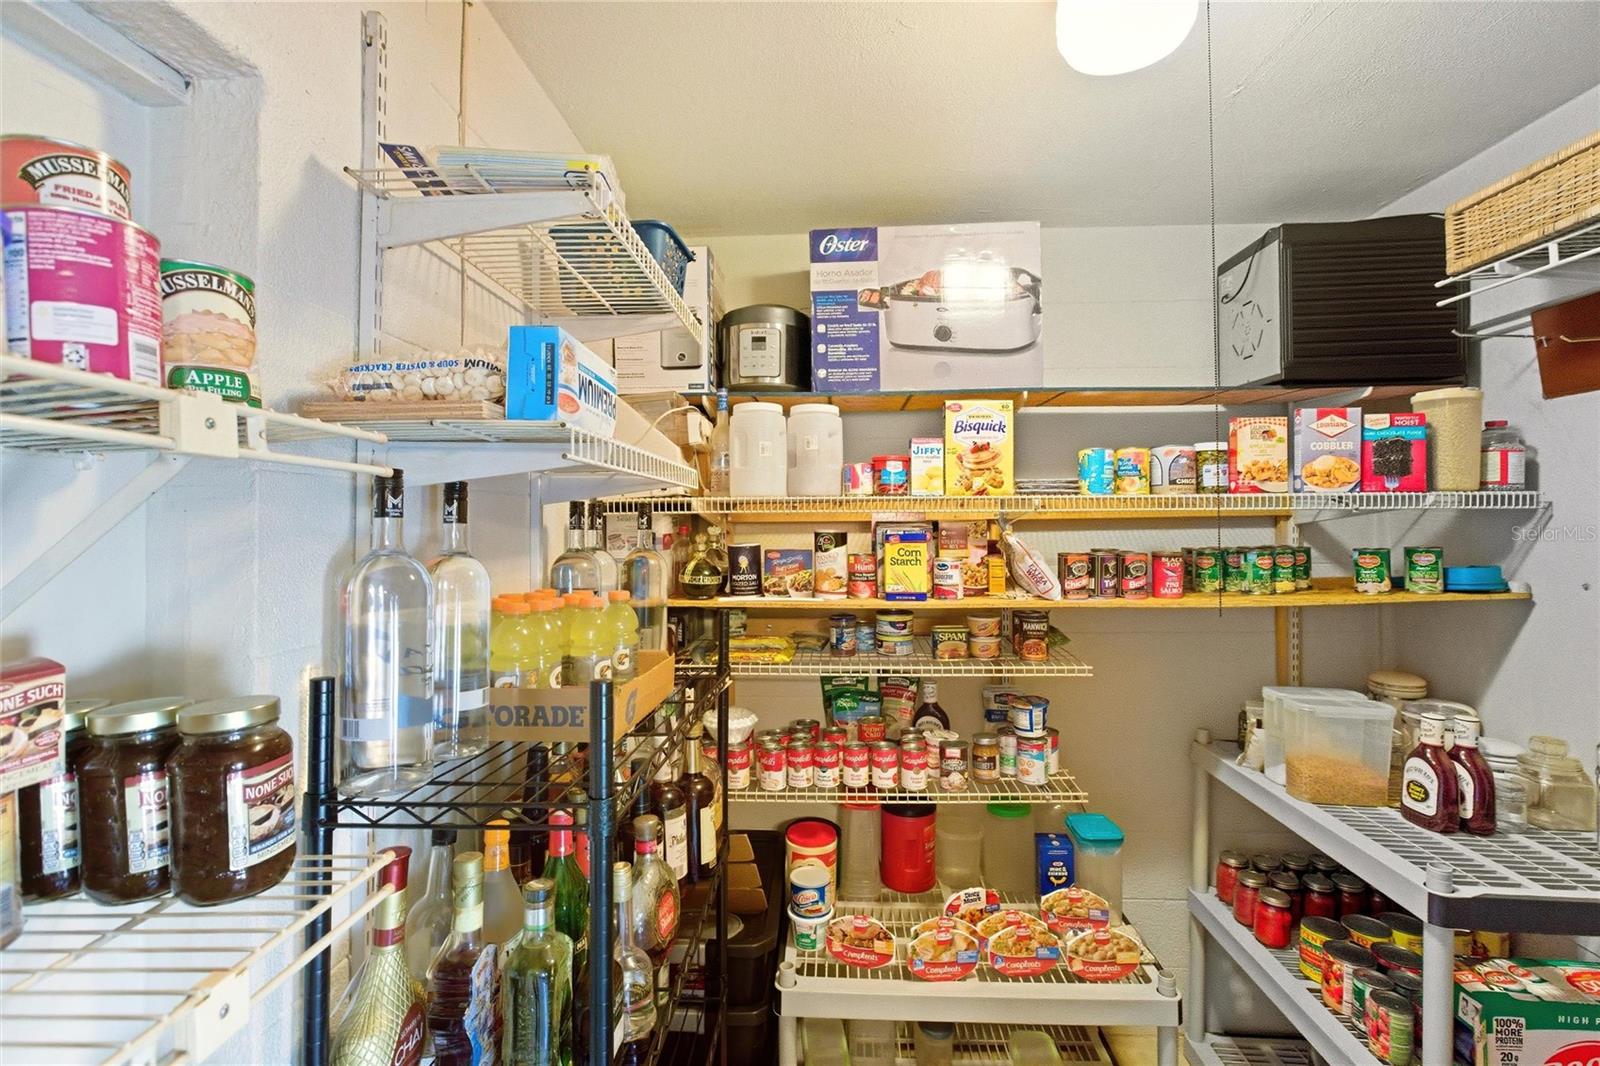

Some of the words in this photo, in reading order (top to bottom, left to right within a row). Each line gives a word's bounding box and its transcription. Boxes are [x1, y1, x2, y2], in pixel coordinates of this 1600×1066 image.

[54, 184, 93, 199] FRIED
[819, 234, 869, 255] Oster
[350, 363, 392, 372] CRACKERS
[395, 361, 428, 371] OYSTER
[437, 359, 459, 368] SOUP
[186, 369, 244, 388] APPLE
[953, 419, 1007, 434] Bisquick
[912, 445, 942, 455] JIFFY
[1310, 441, 1354, 450] COBBLER
[897, 548, 922, 557] Corn
[890, 557, 922, 566] Starch
[938, 632, 966, 641] SPAM
[27, 683, 62, 701] SUCH
[245, 780, 277, 800] NONE
[1495, 1018, 1524, 1029] 100%
[1558, 1015, 1590, 1025] HIGH
[1495, 1028, 1523, 1037] MORE
[1495, 1036, 1523, 1045] PROTEIN
[1500, 1051, 1513, 1062] 20
